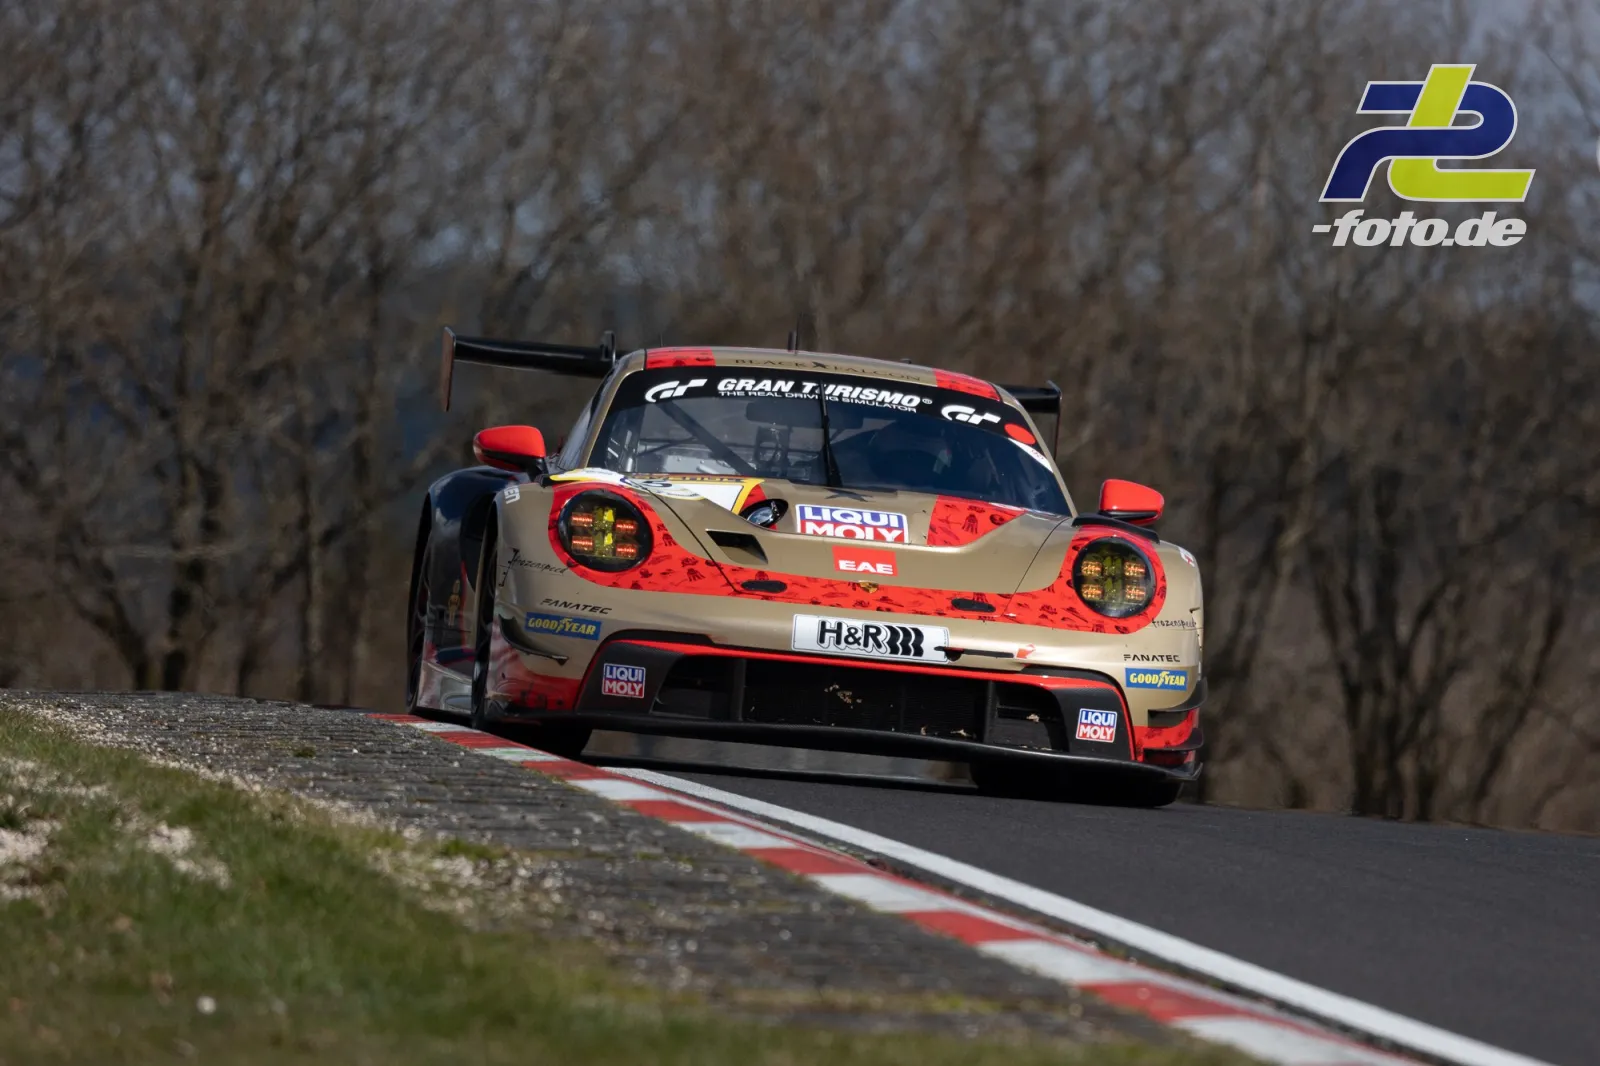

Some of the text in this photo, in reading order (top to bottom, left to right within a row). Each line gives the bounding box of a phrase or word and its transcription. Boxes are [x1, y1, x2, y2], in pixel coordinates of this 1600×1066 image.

[735, 359, 921, 381] BLACK FALCON
[717, 378, 796, 393] GRAN
[785, 392, 840, 402] DRIVIG
[842, 397, 917, 414] SIMULATOR
[803, 506, 900, 528] LIQUI
[838, 559, 894, 575] EAE
[540, 598, 613, 615] FANATEC
[528, 617, 597, 636] GOODYEAR
[817, 620, 887, 654] H&R
[1123, 653, 1181, 663] FANATEC
[606, 665, 643, 682] LIQUI
[1129, 671, 1186, 688] GOODYEAR
[605, 680, 643, 696] MOLY
[1081, 710, 1115, 727] LIQUI
[1079, 724, 1115, 740] MOLY
